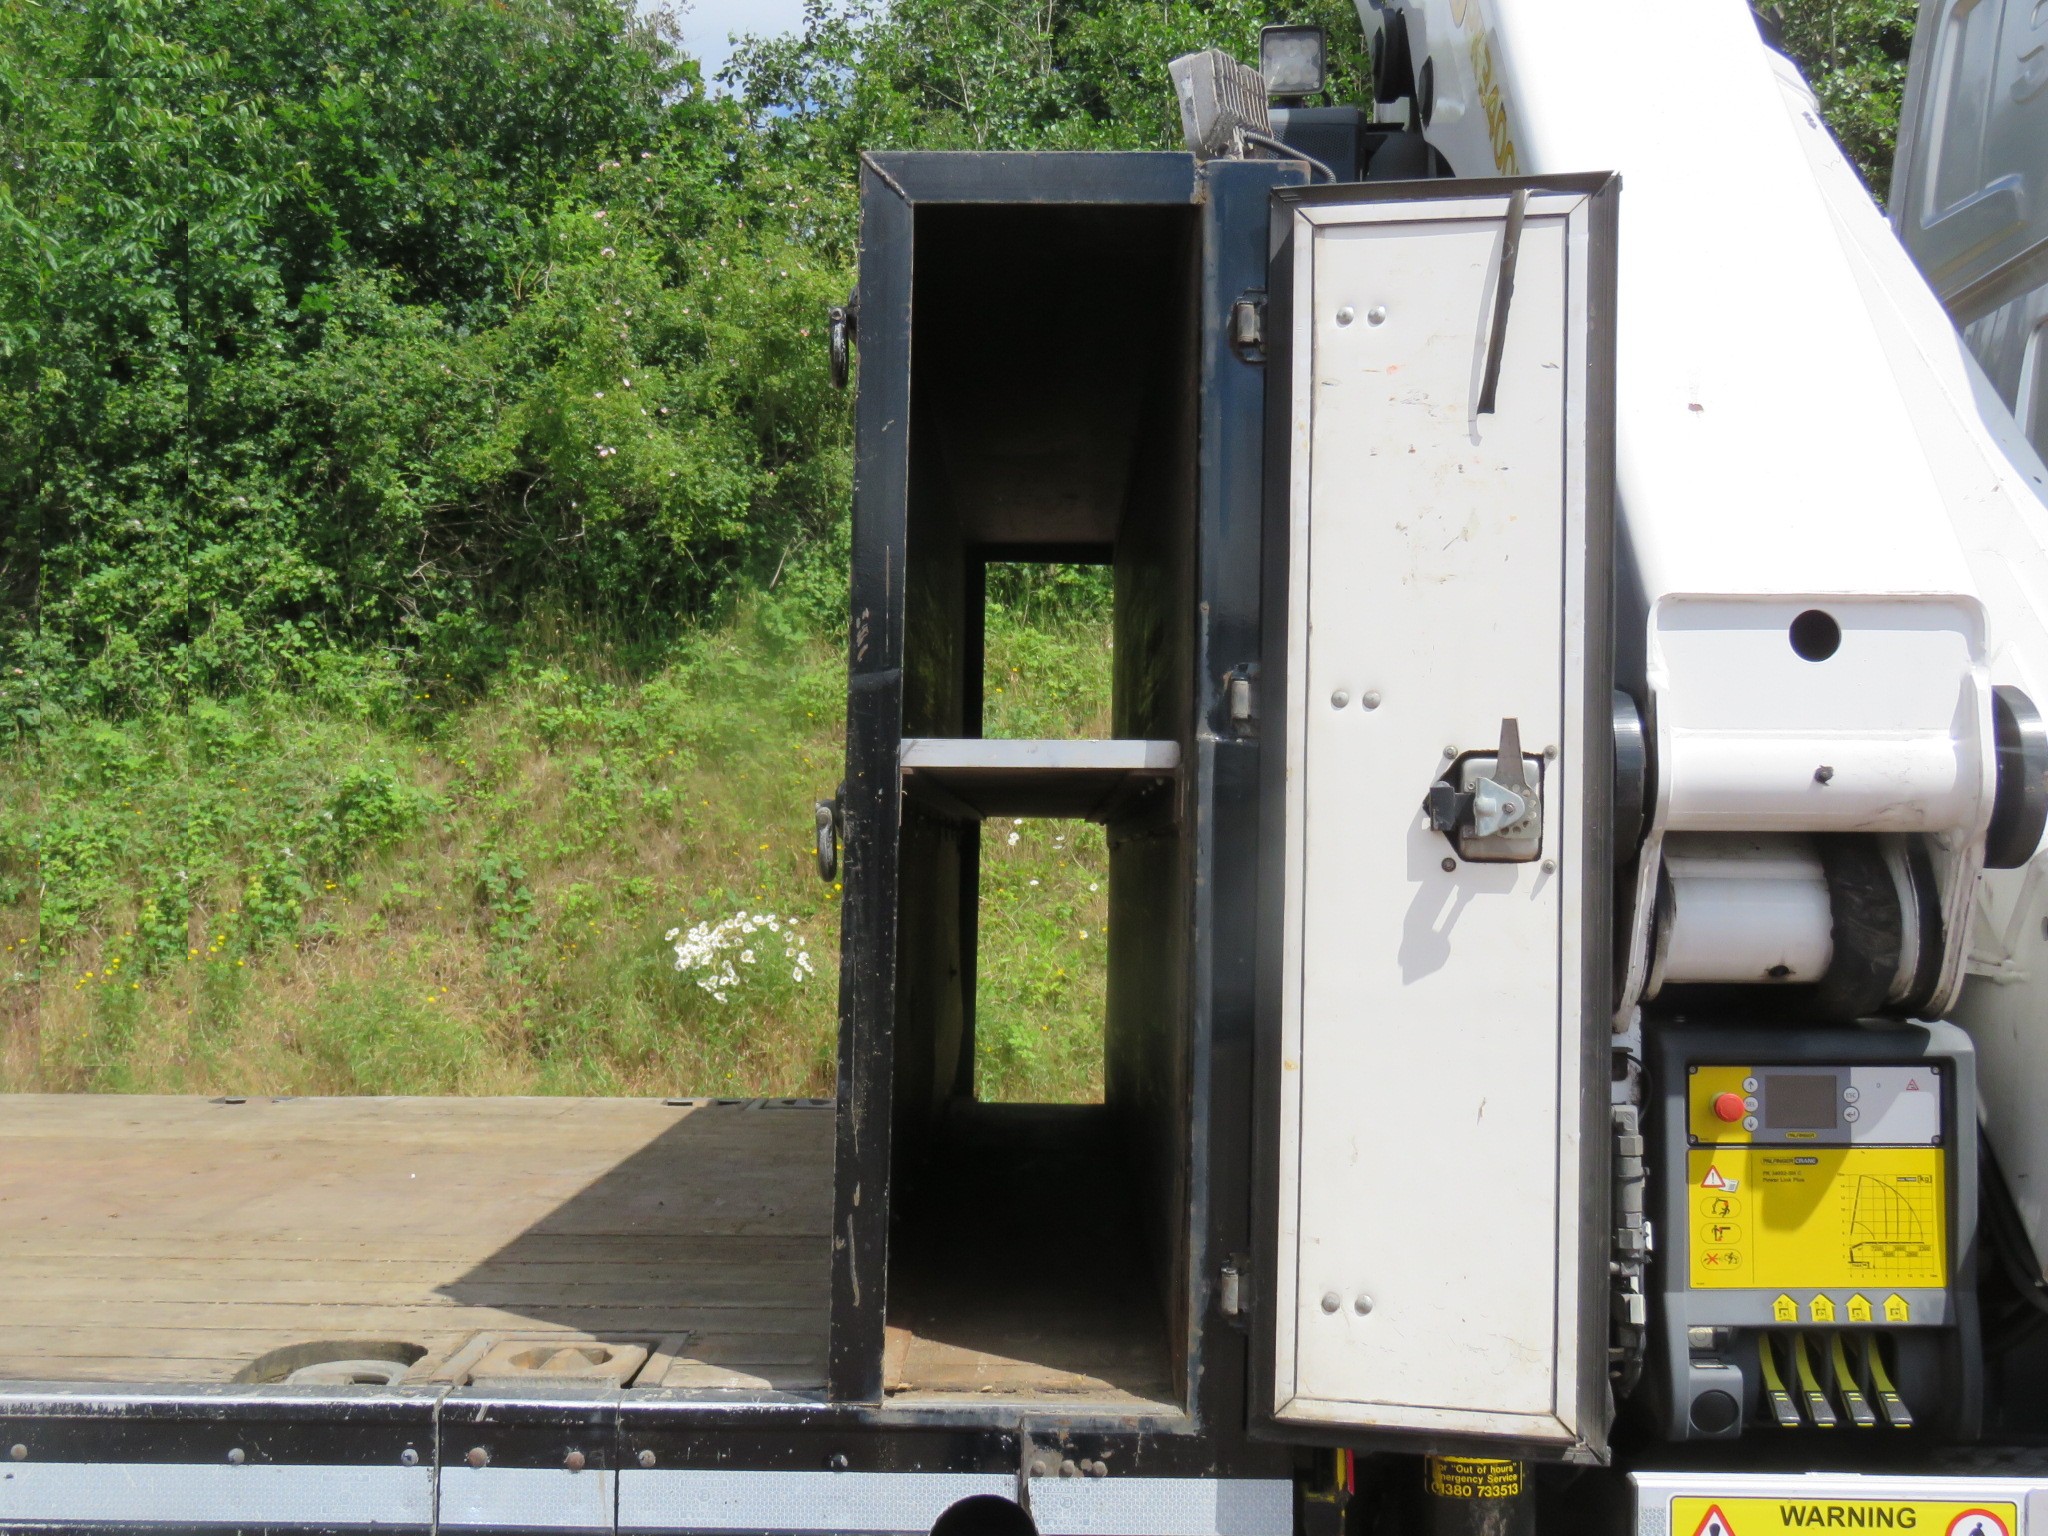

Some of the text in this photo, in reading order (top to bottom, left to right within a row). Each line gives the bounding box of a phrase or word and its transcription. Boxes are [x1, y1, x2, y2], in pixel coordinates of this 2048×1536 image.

[1477, 1465, 1487, 1474] of
[1487, 1473, 1518, 1483] Service
[1476, 1482, 1519, 1498] 733513
[1779, 1505, 1917, 1529] WARNING
